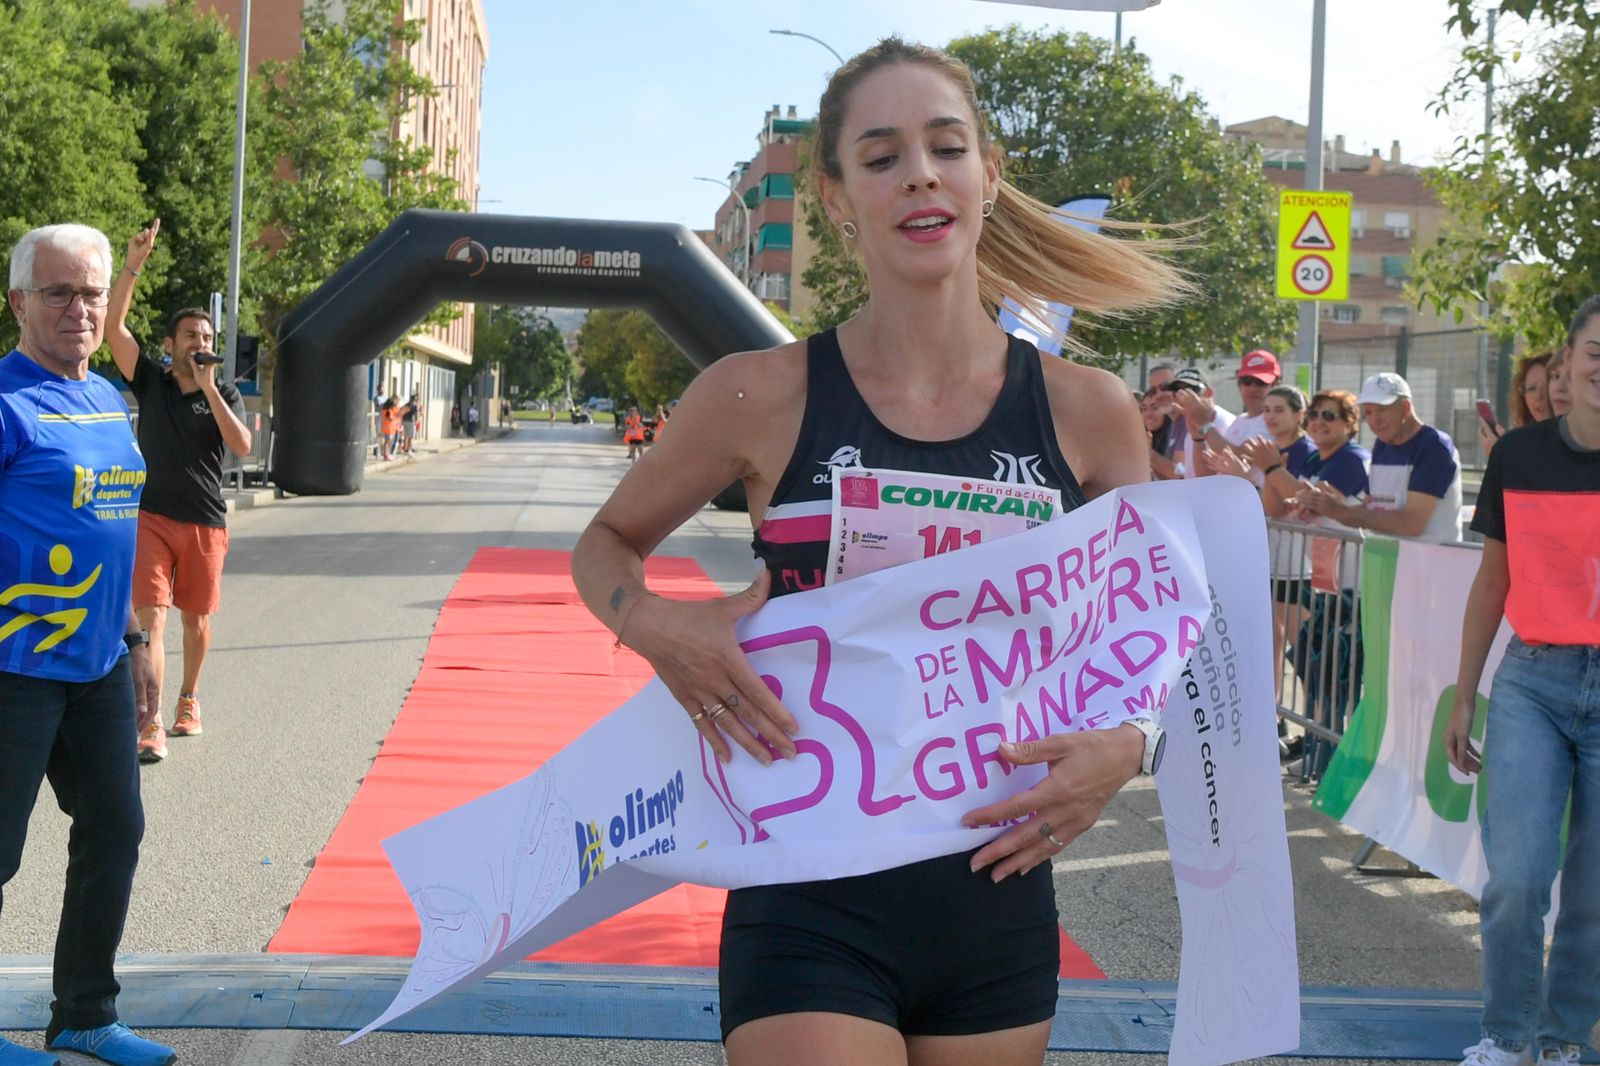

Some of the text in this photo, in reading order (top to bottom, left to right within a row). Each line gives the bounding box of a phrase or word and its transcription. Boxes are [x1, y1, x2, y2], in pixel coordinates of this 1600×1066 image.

[1301, 267, 1324, 281] 20
[96, 489, 132, 501] deportes
[880, 484, 1055, 522] COVIRAN
[976, 483, 1053, 503] Fundación
[95, 510, 118, 520] TRAIL
[842, 517, 847, 527] 1
[841, 530, 847, 539] 2
[840, 543, 846, 552] 3
[838, 555, 844, 563] 4
[919, 497, 1145, 630] CARREA
[914, 645, 959, 683] DE
[923, 683, 965, 720] LA
[1193, 707, 1212, 734] el
[1200, 742, 1221, 849] cáncer
[608, 769, 684, 849] olimpo
